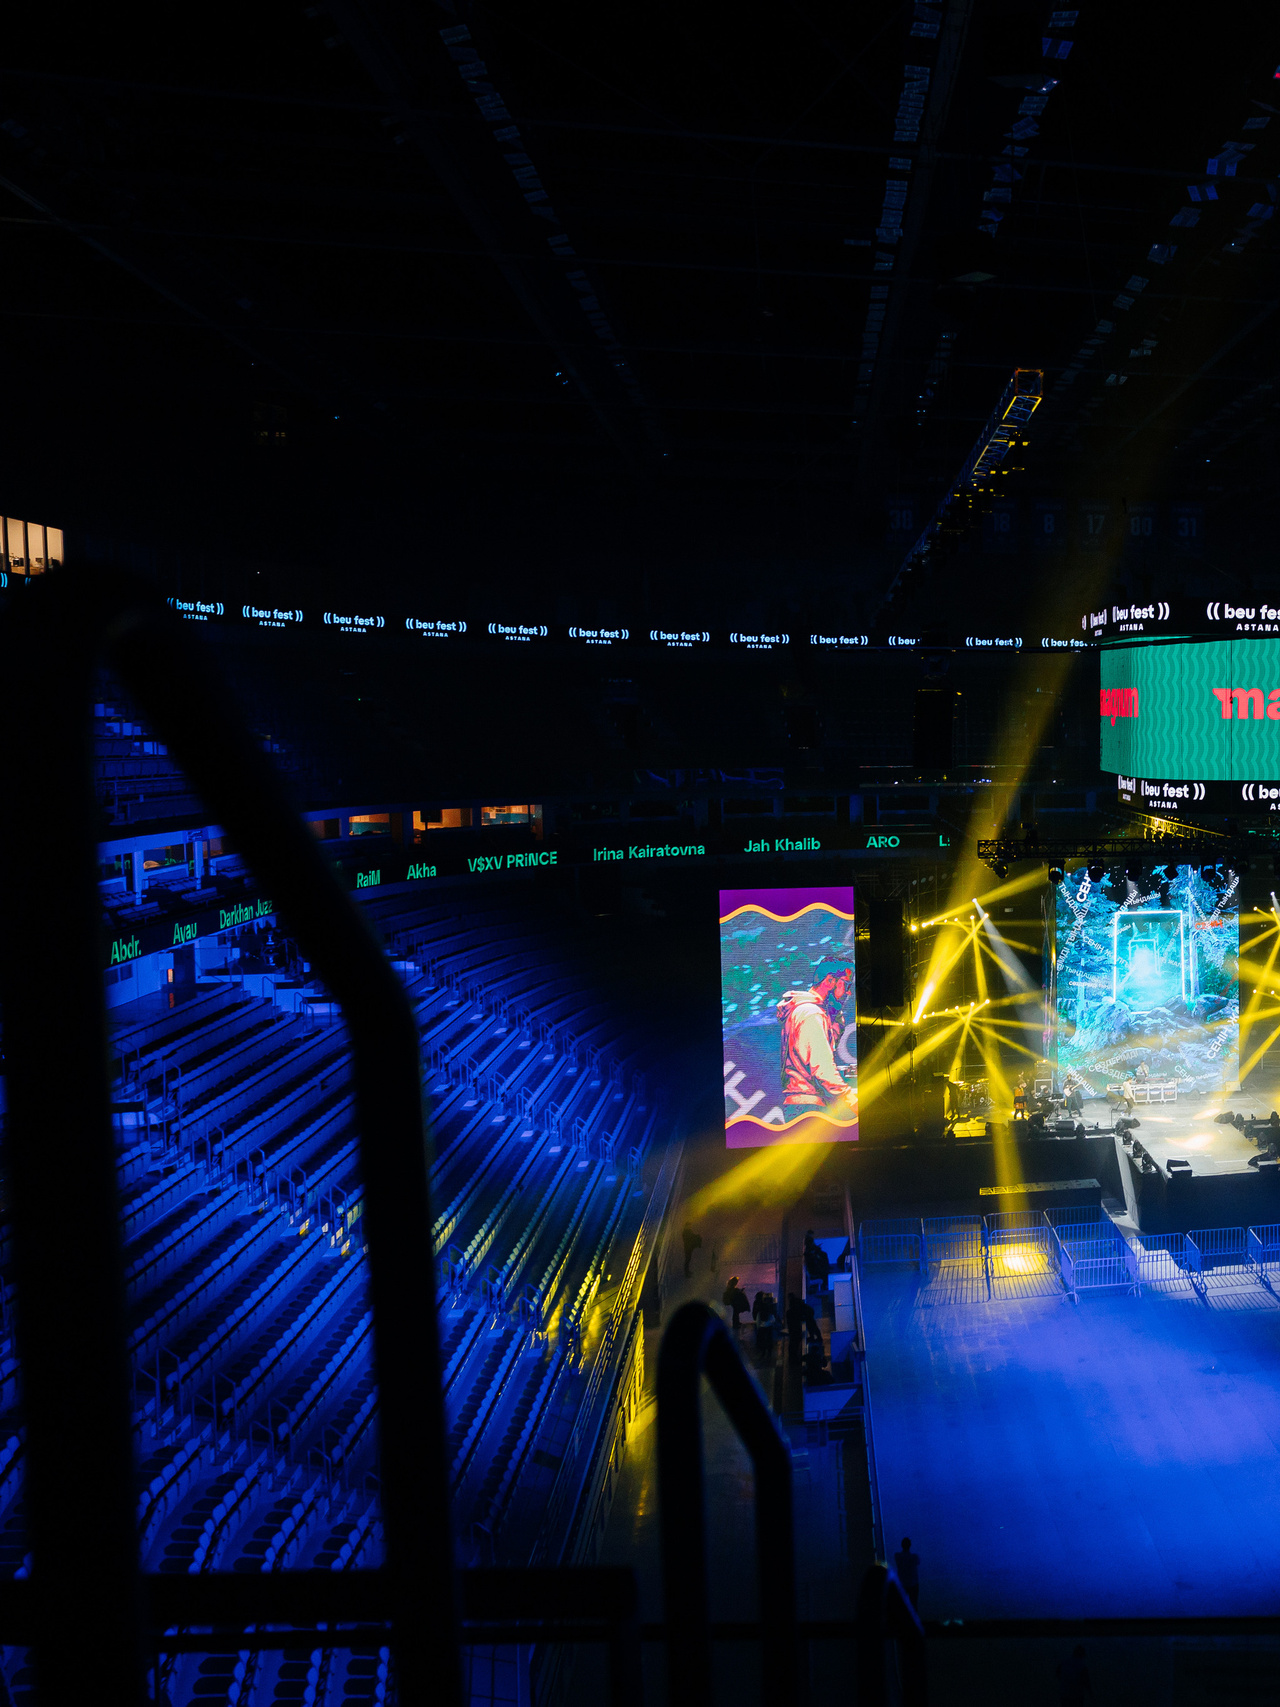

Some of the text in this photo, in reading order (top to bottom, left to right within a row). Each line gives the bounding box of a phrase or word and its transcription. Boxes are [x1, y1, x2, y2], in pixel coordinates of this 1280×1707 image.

[176, 599, 214, 614] beu fest
[1117, 604, 1154, 620] beu fest
[1224, 603, 1256, 621] beu
[252, 607, 293, 621] beu fest
[333, 613, 374, 627] beu fest
[416, 619, 456, 632] beu fest
[498, 624, 538, 636] beu fest
[1236, 623, 1280, 632] ASTANA
[579, 628, 620, 639] beu fest
[660, 631, 700, 642] beu fest
[740, 633, 780, 644] beu fest
[819, 635, 859, 645] beu fest
[898, 636, 916, 646] beu
[975, 637, 1014, 647] beu fest
[1051, 638, 1068, 648] beu
[1144, 782, 1160, 798] beu
[1162, 784, 1190, 799] fest
[744, 837, 821, 853] Jah Khalib
[866, 835, 900, 849] ARO
[593, 842, 706, 862] Irina Kairatovna
[467, 854, 503, 874] V$XV
[356, 869, 381, 888] RaiM
[406, 863, 437, 881] Akha
[219, 903, 254, 930] Darkhan
[110, 935, 142, 965] Abdr.
